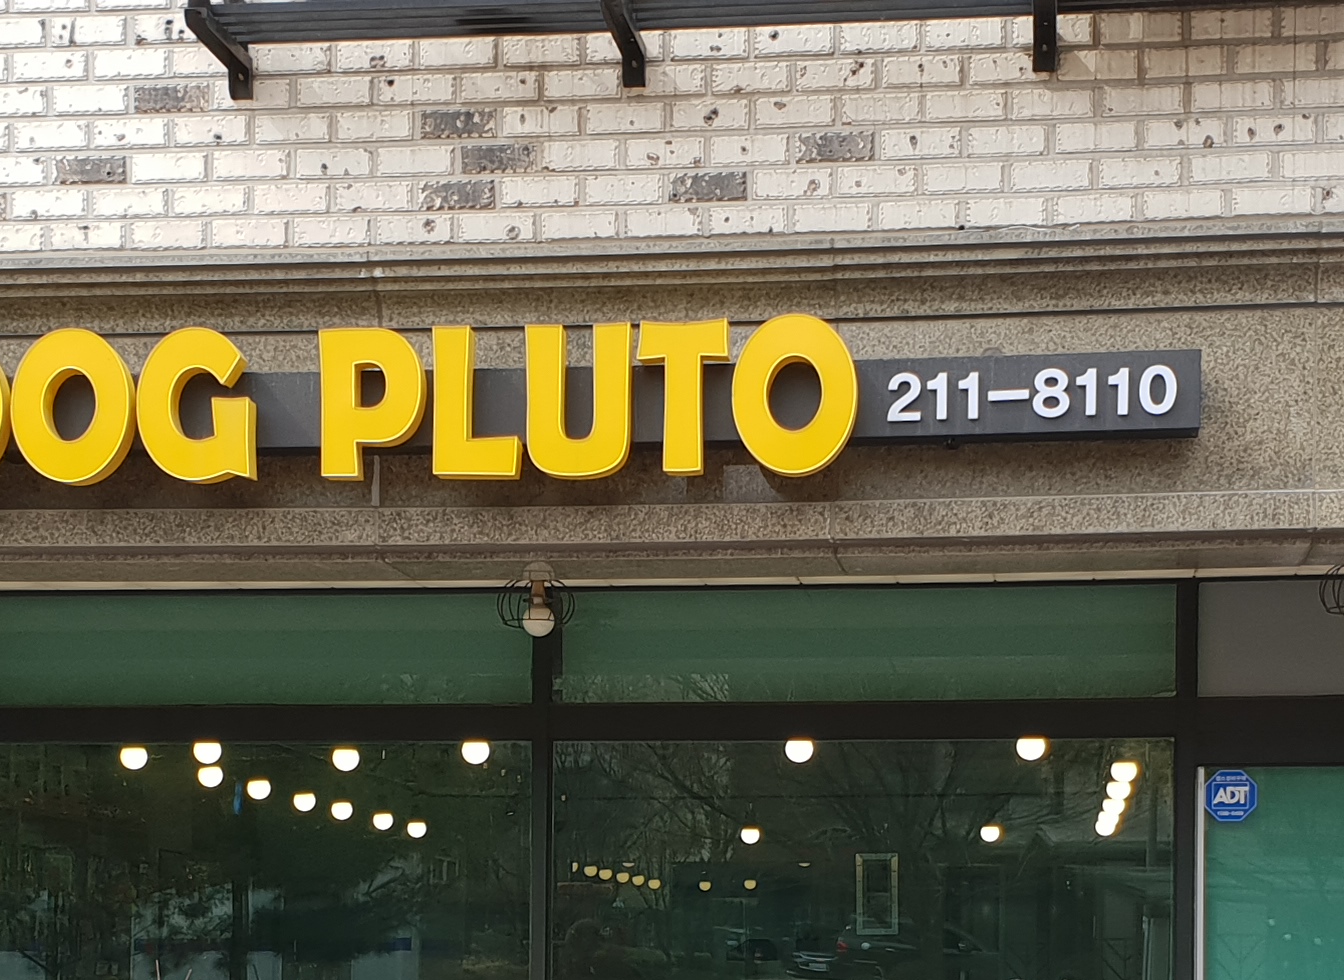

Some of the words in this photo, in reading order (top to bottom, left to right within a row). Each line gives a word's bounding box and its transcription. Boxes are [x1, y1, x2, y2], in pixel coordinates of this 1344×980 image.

[319, 314, 857, 479] PLUTO
[887, 365, 1177, 421] 211-8110
[1213, 786, 1249, 805] ADT
